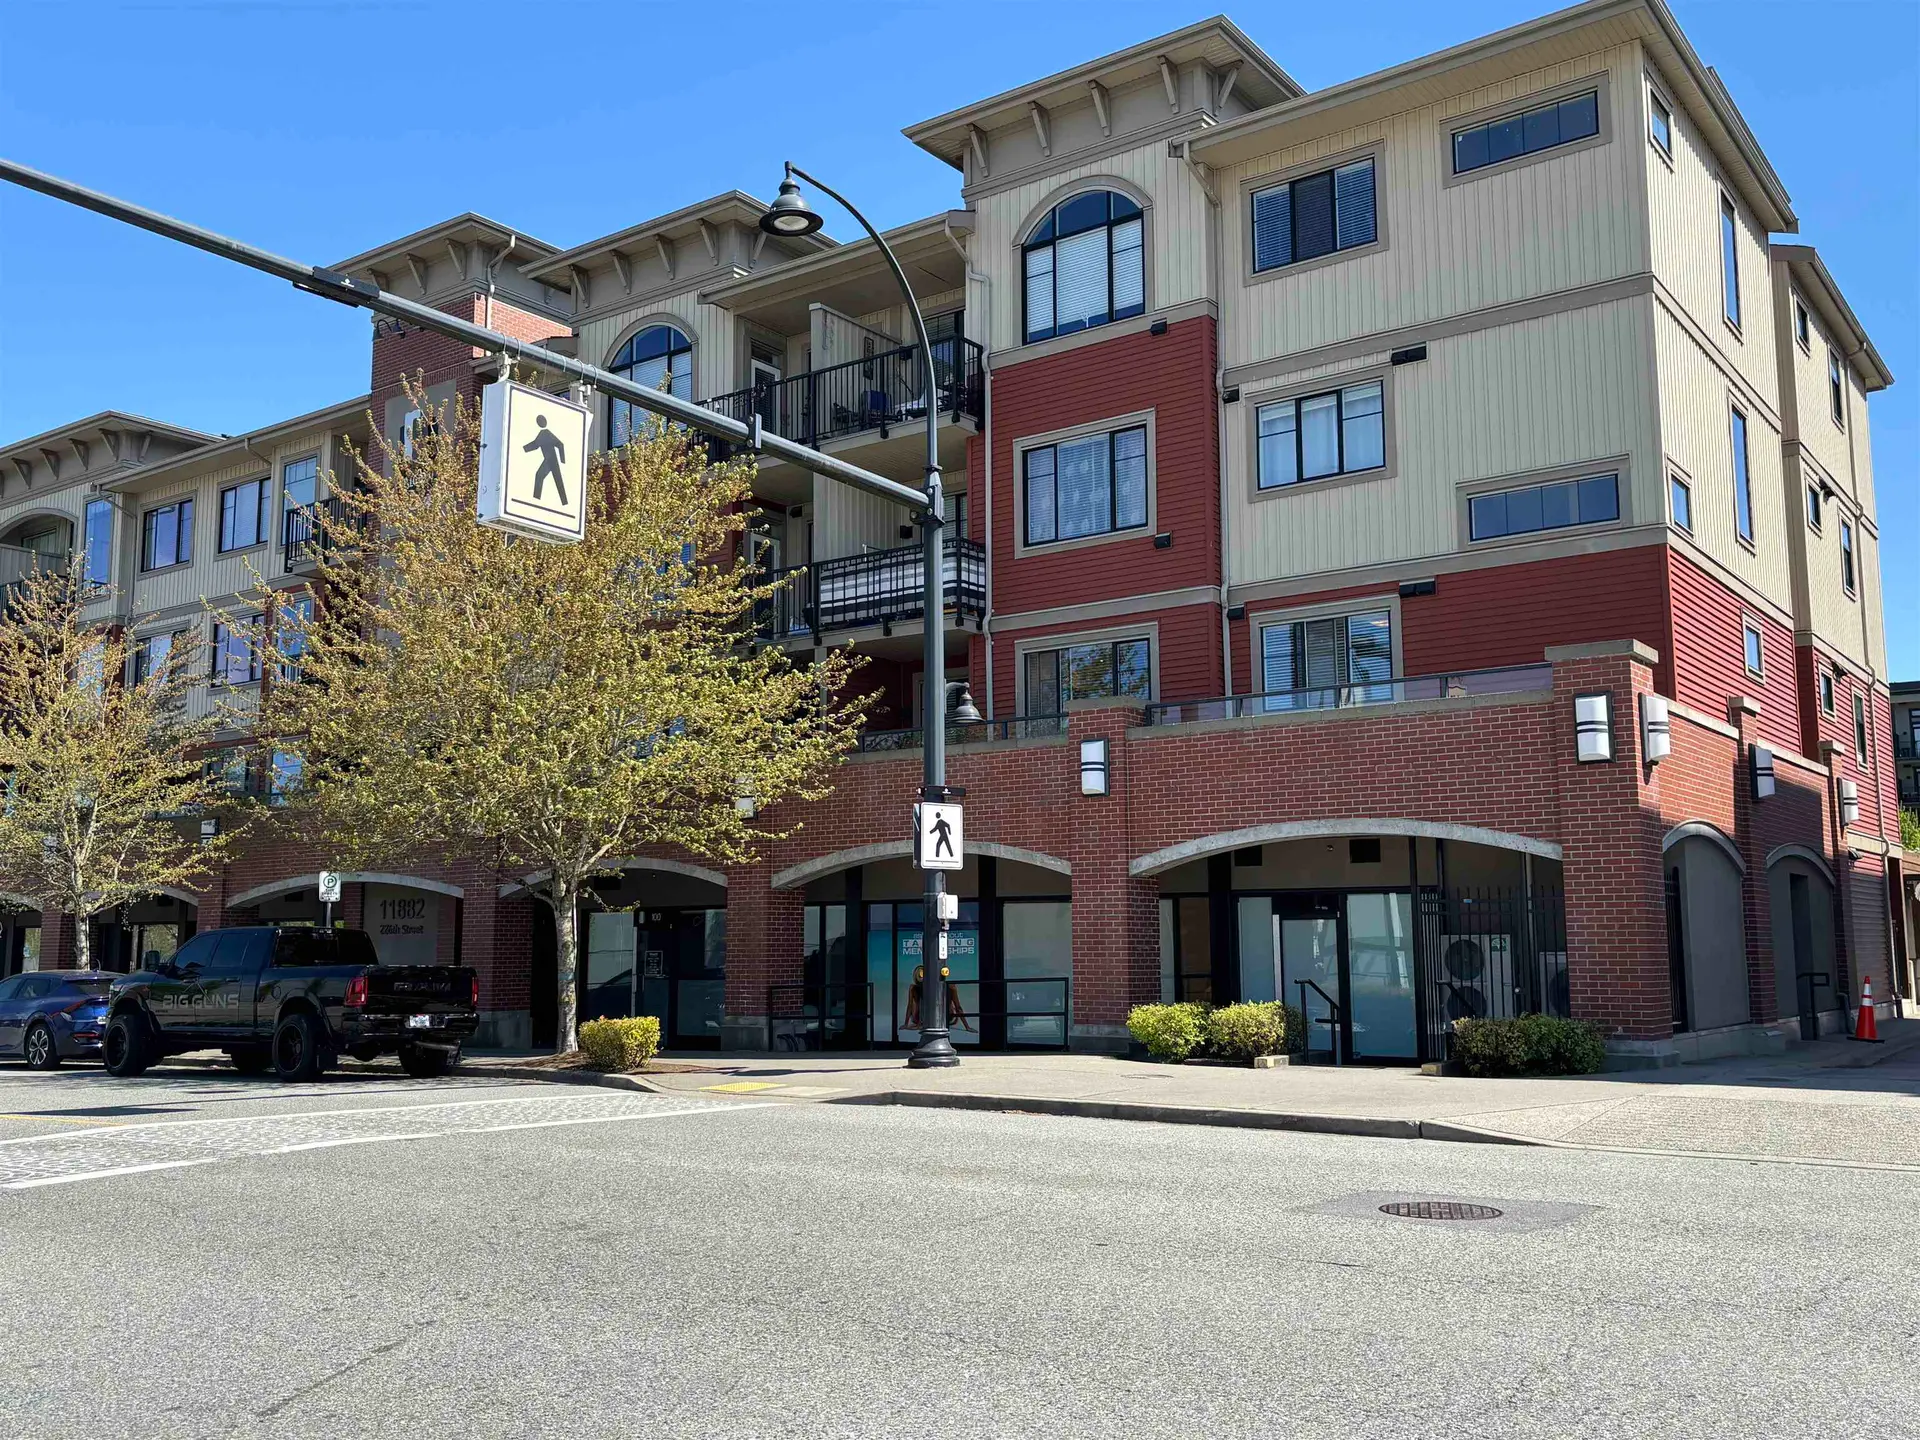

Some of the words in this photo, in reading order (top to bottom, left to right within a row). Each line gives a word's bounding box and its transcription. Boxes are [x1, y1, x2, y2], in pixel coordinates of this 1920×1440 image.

[380, 898, 425, 919] 11882
[163, 994, 189, 1009] BIG
[191, 993, 239, 1009] GUNS
